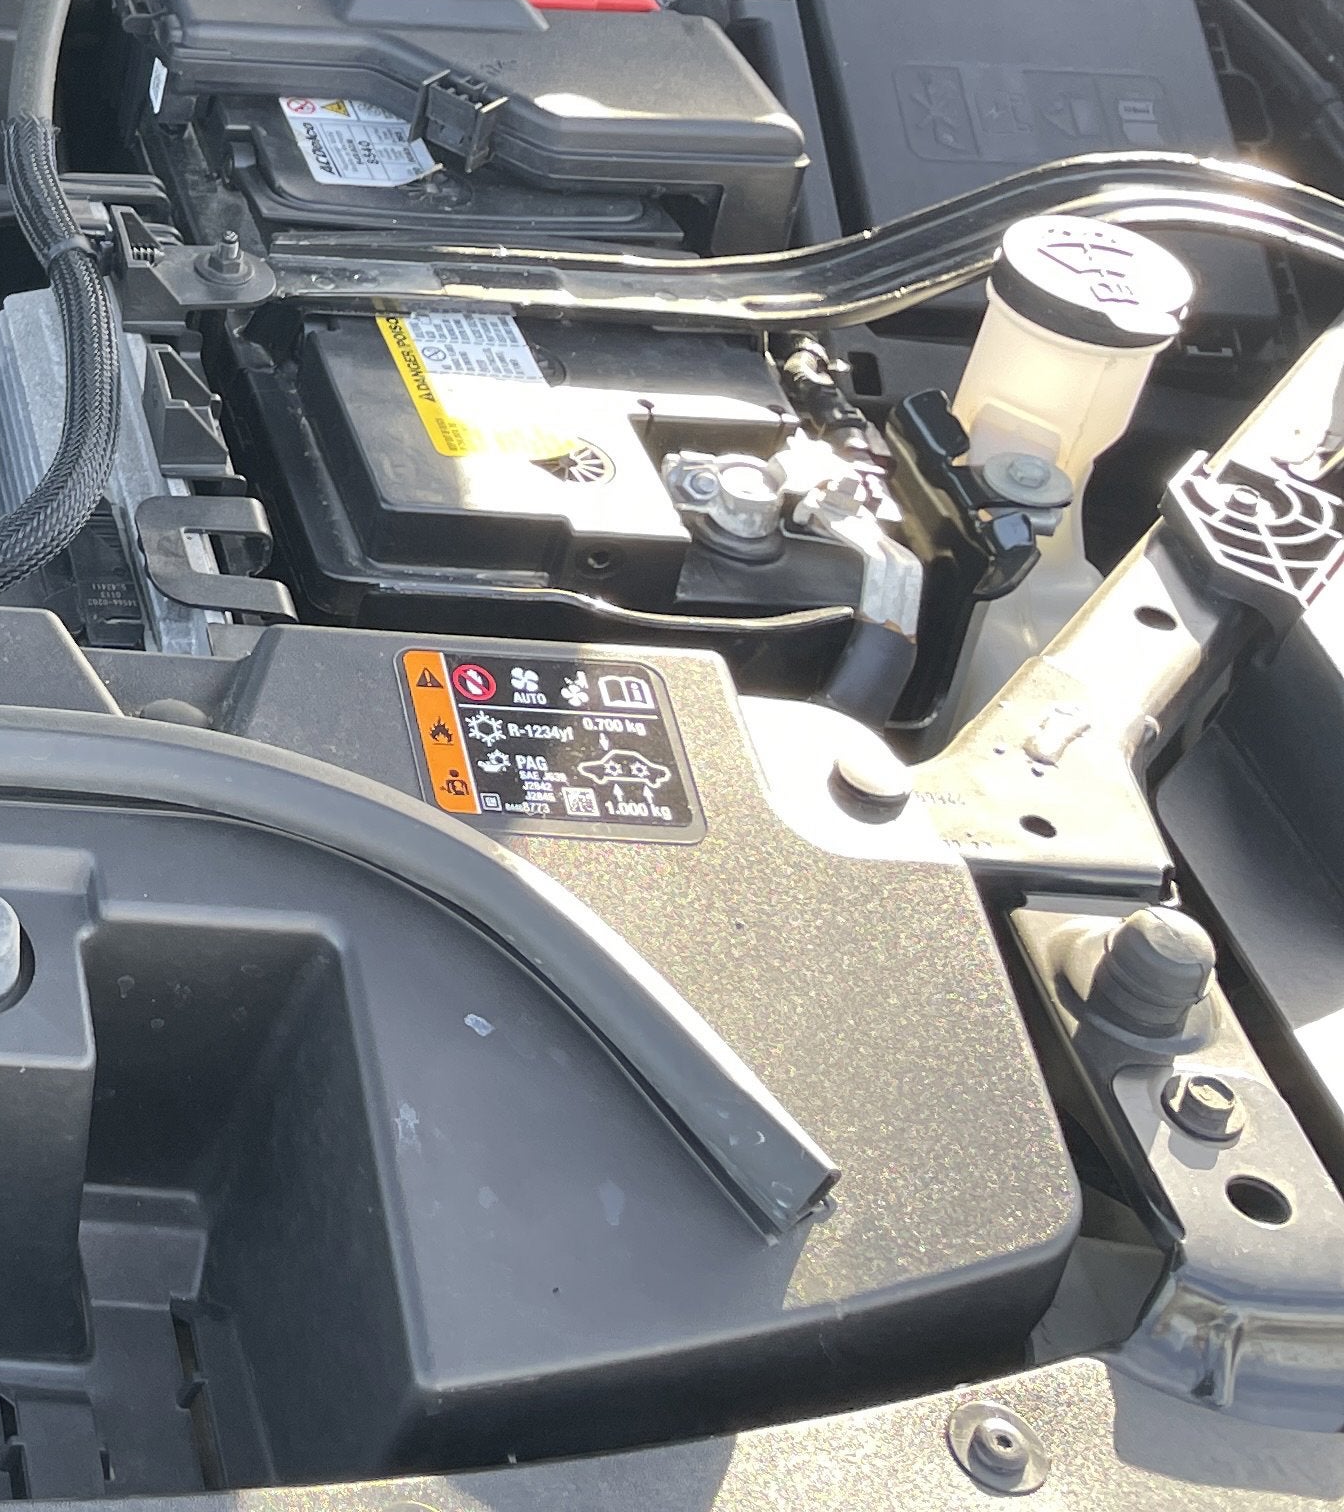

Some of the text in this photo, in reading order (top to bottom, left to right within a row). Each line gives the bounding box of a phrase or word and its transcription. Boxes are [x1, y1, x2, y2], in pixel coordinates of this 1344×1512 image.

[303, 122, 336, 175] ACDelco
[385, 317, 407, 348] POISO
[513, 692, 547, 705] AUTO
[583, 717, 647, 736] 0.700 kg
[515, 754, 548, 771] PAG
[605, 800, 672, 820] 1.000 kg
